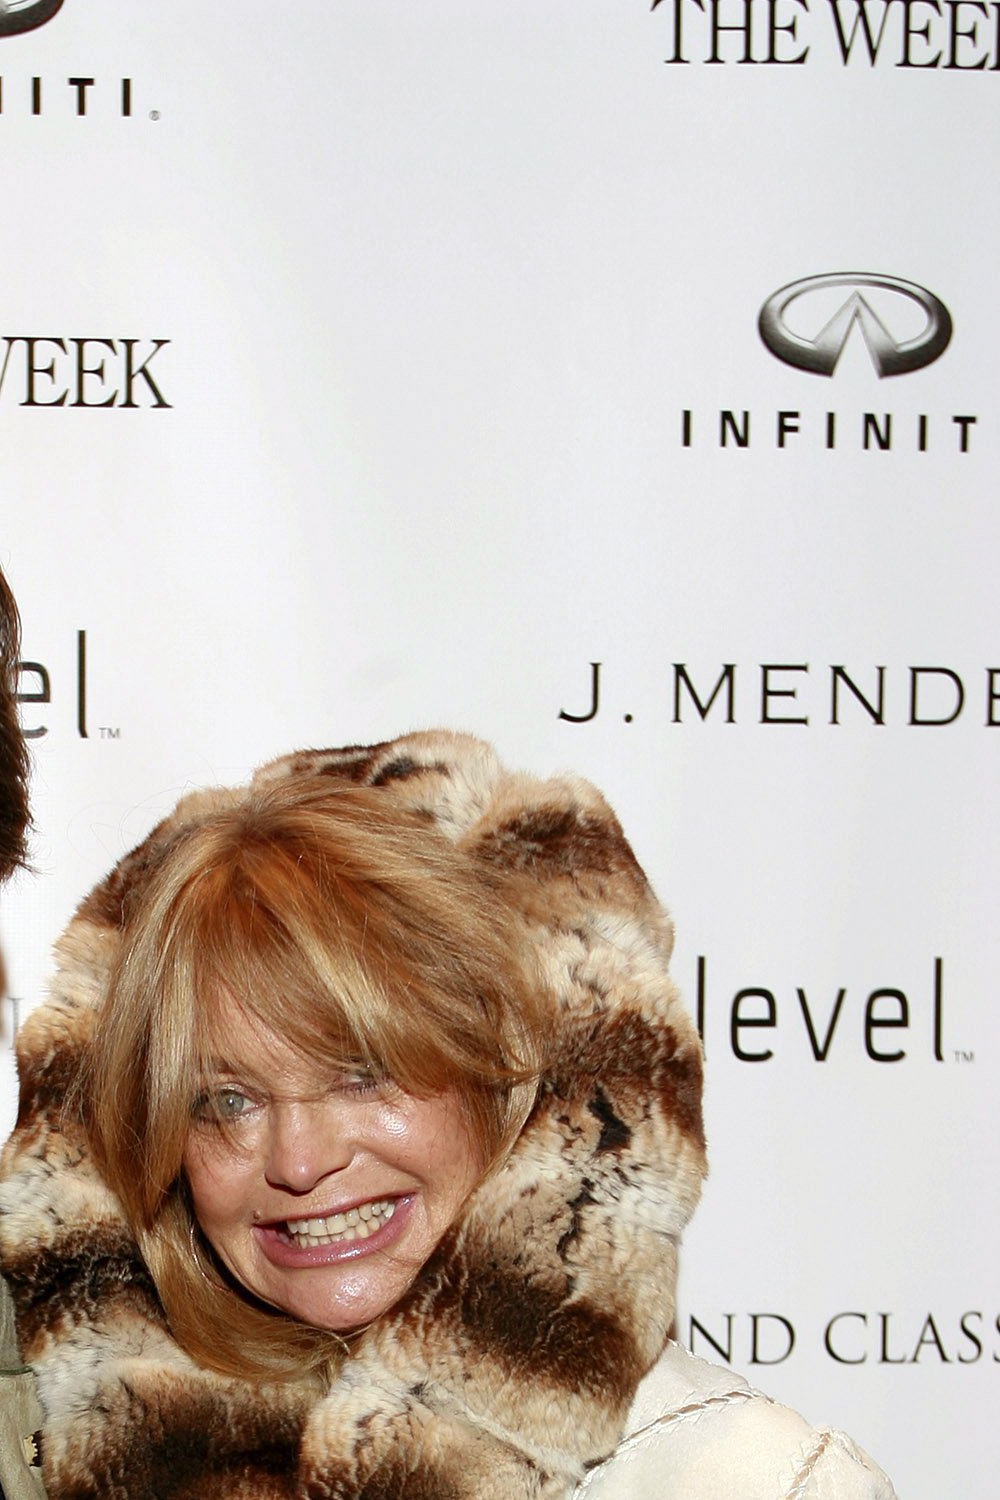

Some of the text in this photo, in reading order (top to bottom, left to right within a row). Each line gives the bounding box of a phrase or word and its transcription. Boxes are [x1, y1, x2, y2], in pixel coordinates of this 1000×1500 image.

[650, 0, 810, 64] THE
[557, 662, 634, 724] J.
[697, 955, 944, 1063] level
